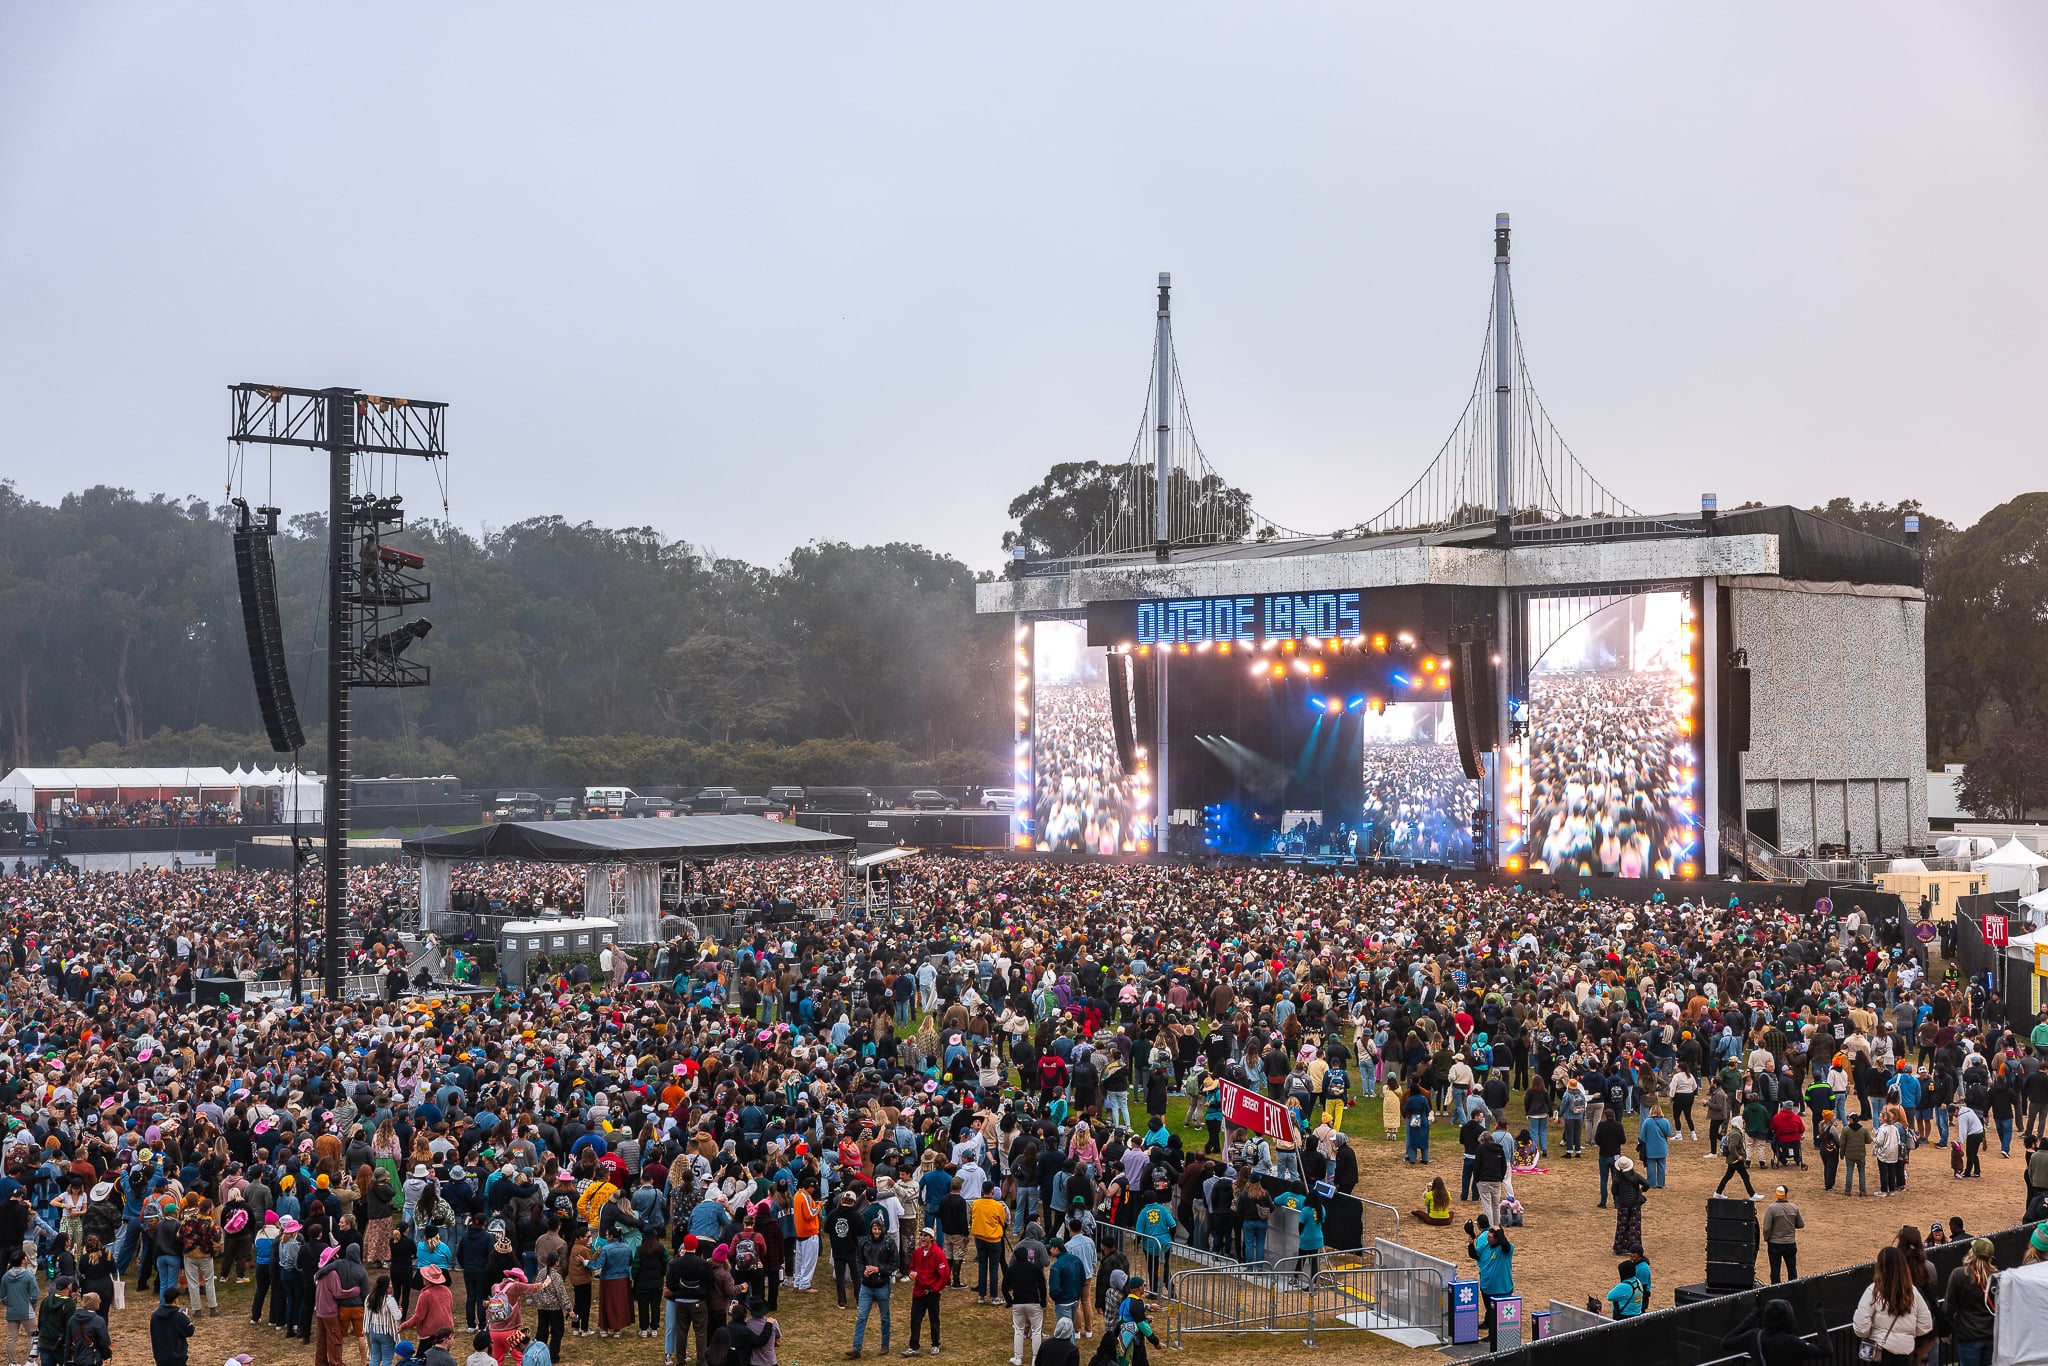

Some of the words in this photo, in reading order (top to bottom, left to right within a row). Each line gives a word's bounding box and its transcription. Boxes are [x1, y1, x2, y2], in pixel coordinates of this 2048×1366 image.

[1137, 598, 1255, 644] OUTSIDE
[1264, 592, 1360, 640] LANDS
[1986, 922, 2005, 940] EXIT
[1221, 1082, 1238, 1119] EXIT
[1264, 1101, 1283, 1139] EXIT
